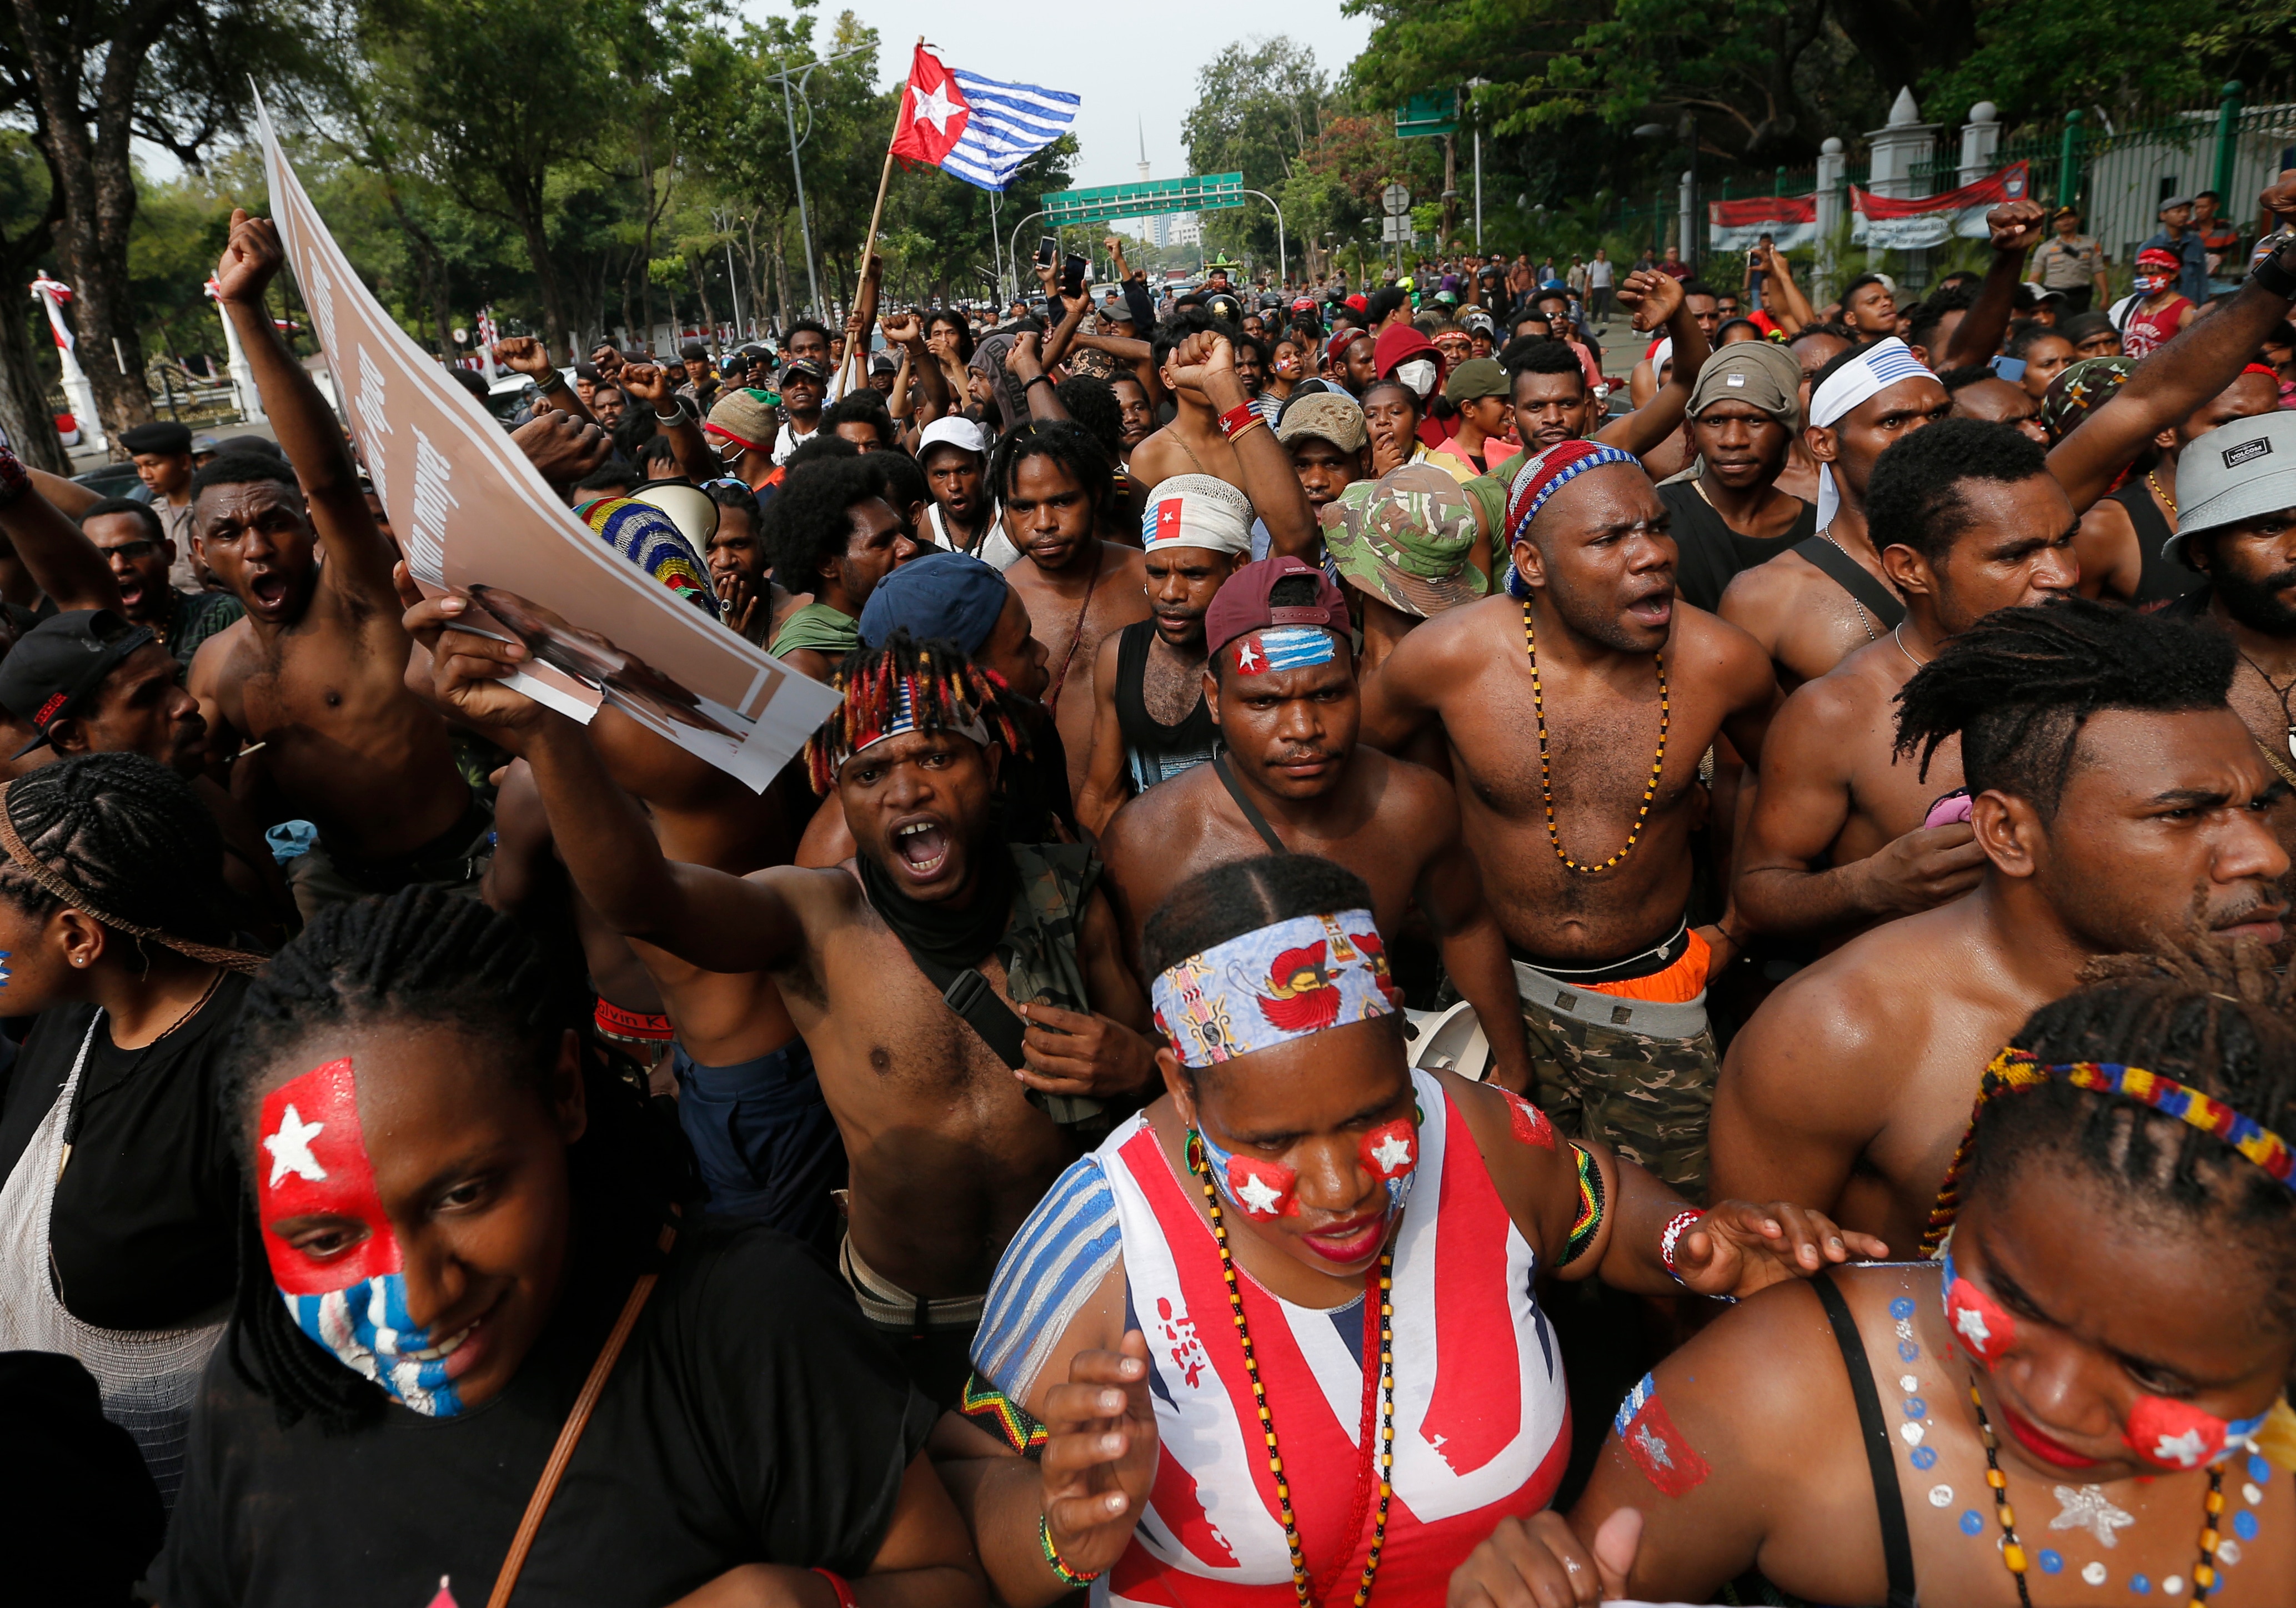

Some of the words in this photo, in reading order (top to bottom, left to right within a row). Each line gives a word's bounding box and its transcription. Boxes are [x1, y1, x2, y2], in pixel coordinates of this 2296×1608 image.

[354, 343, 393, 453] Papua
[2230, 445, 2262, 460] VOLCOM
[410, 423, 460, 543] monyet
[33, 692, 68, 727] TERROR
[596, 1003, 638, 1026] alvin
